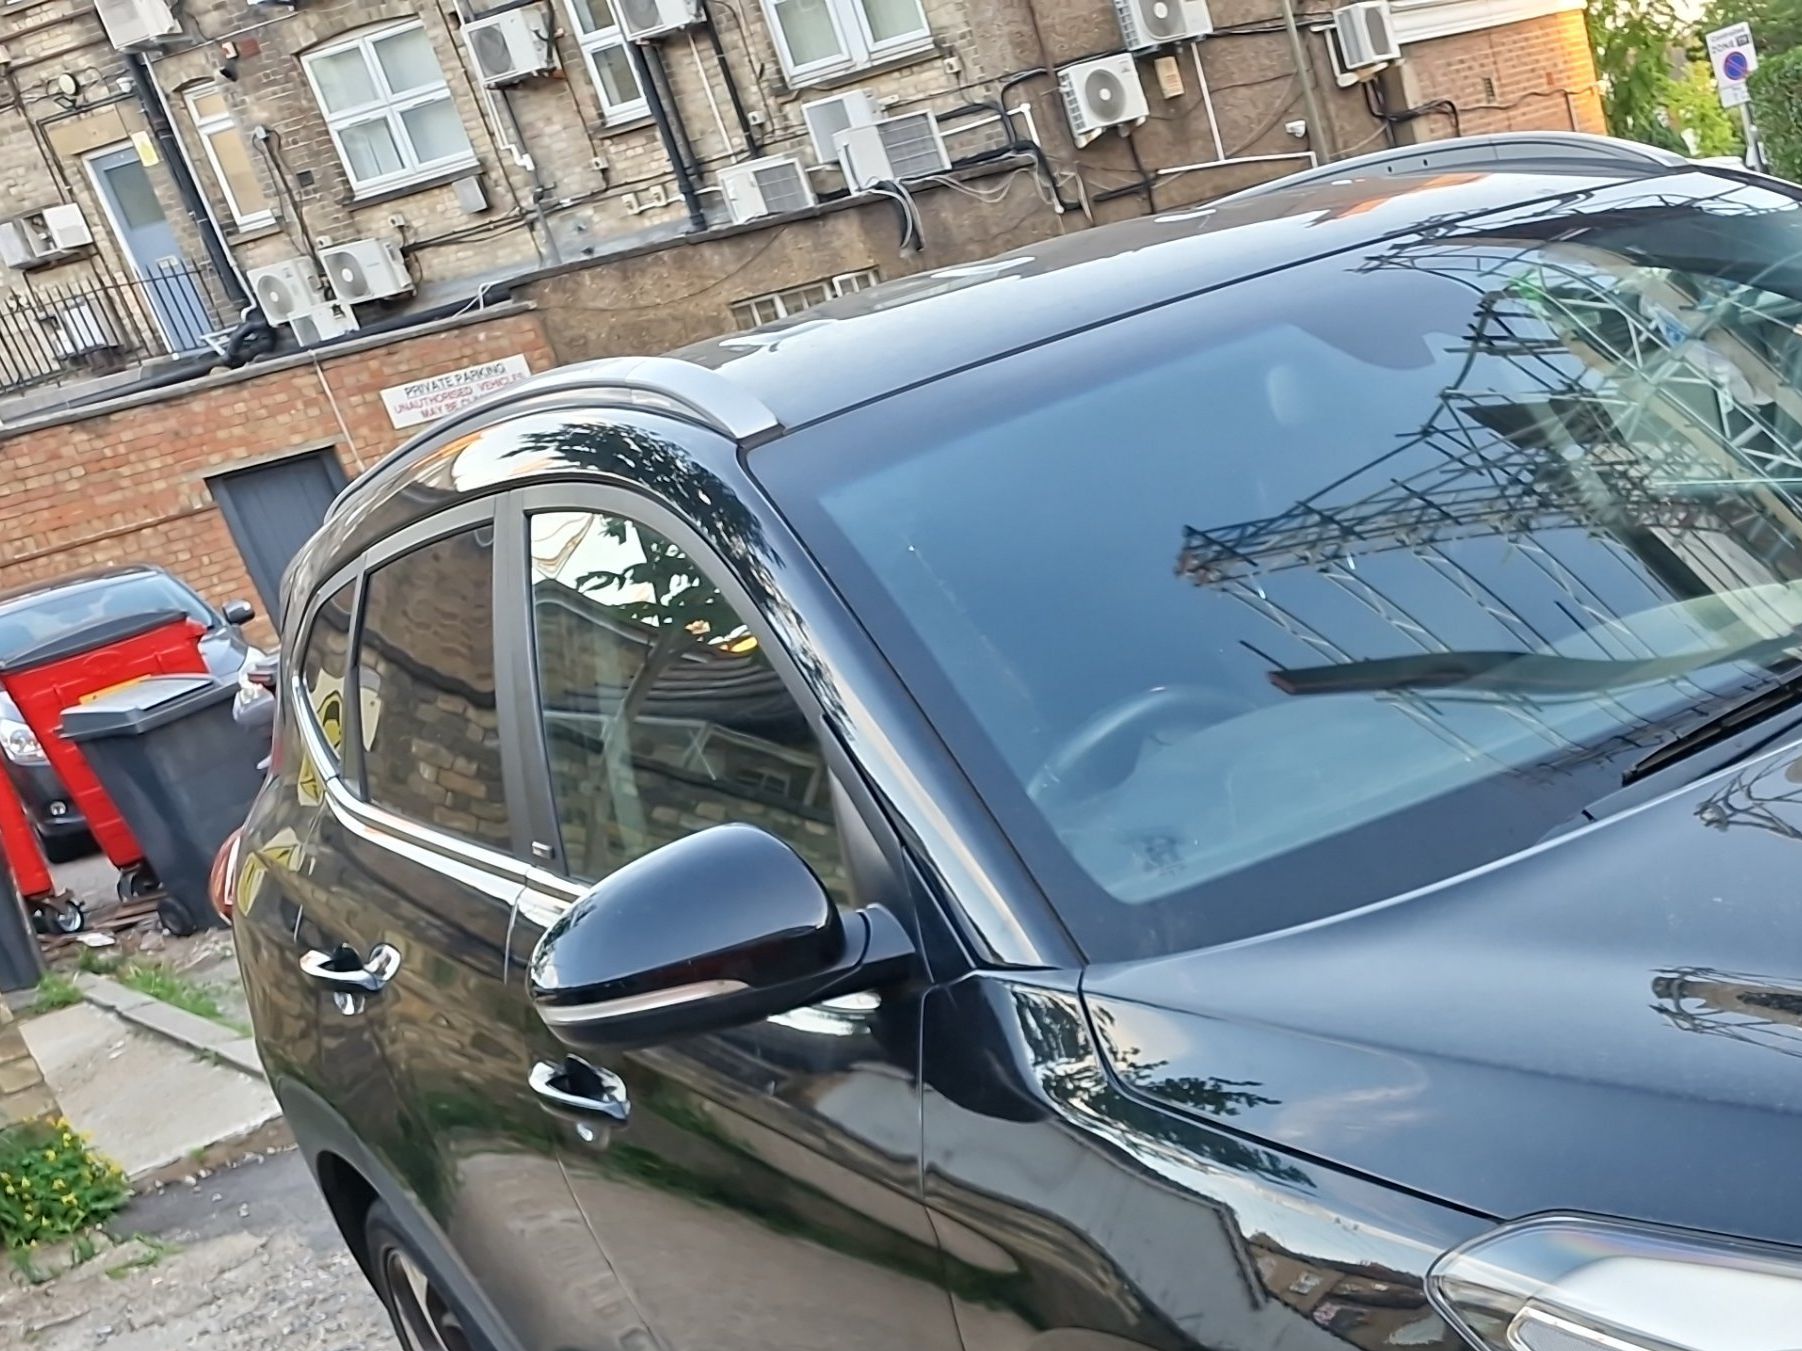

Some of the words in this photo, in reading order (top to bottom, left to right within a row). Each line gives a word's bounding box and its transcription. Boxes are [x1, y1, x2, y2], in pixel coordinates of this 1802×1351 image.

[404, 376, 454, 398] PRIVATE
[455, 362, 507, 384] PARKING
[394, 385, 473, 414] UNAUTHORISED
